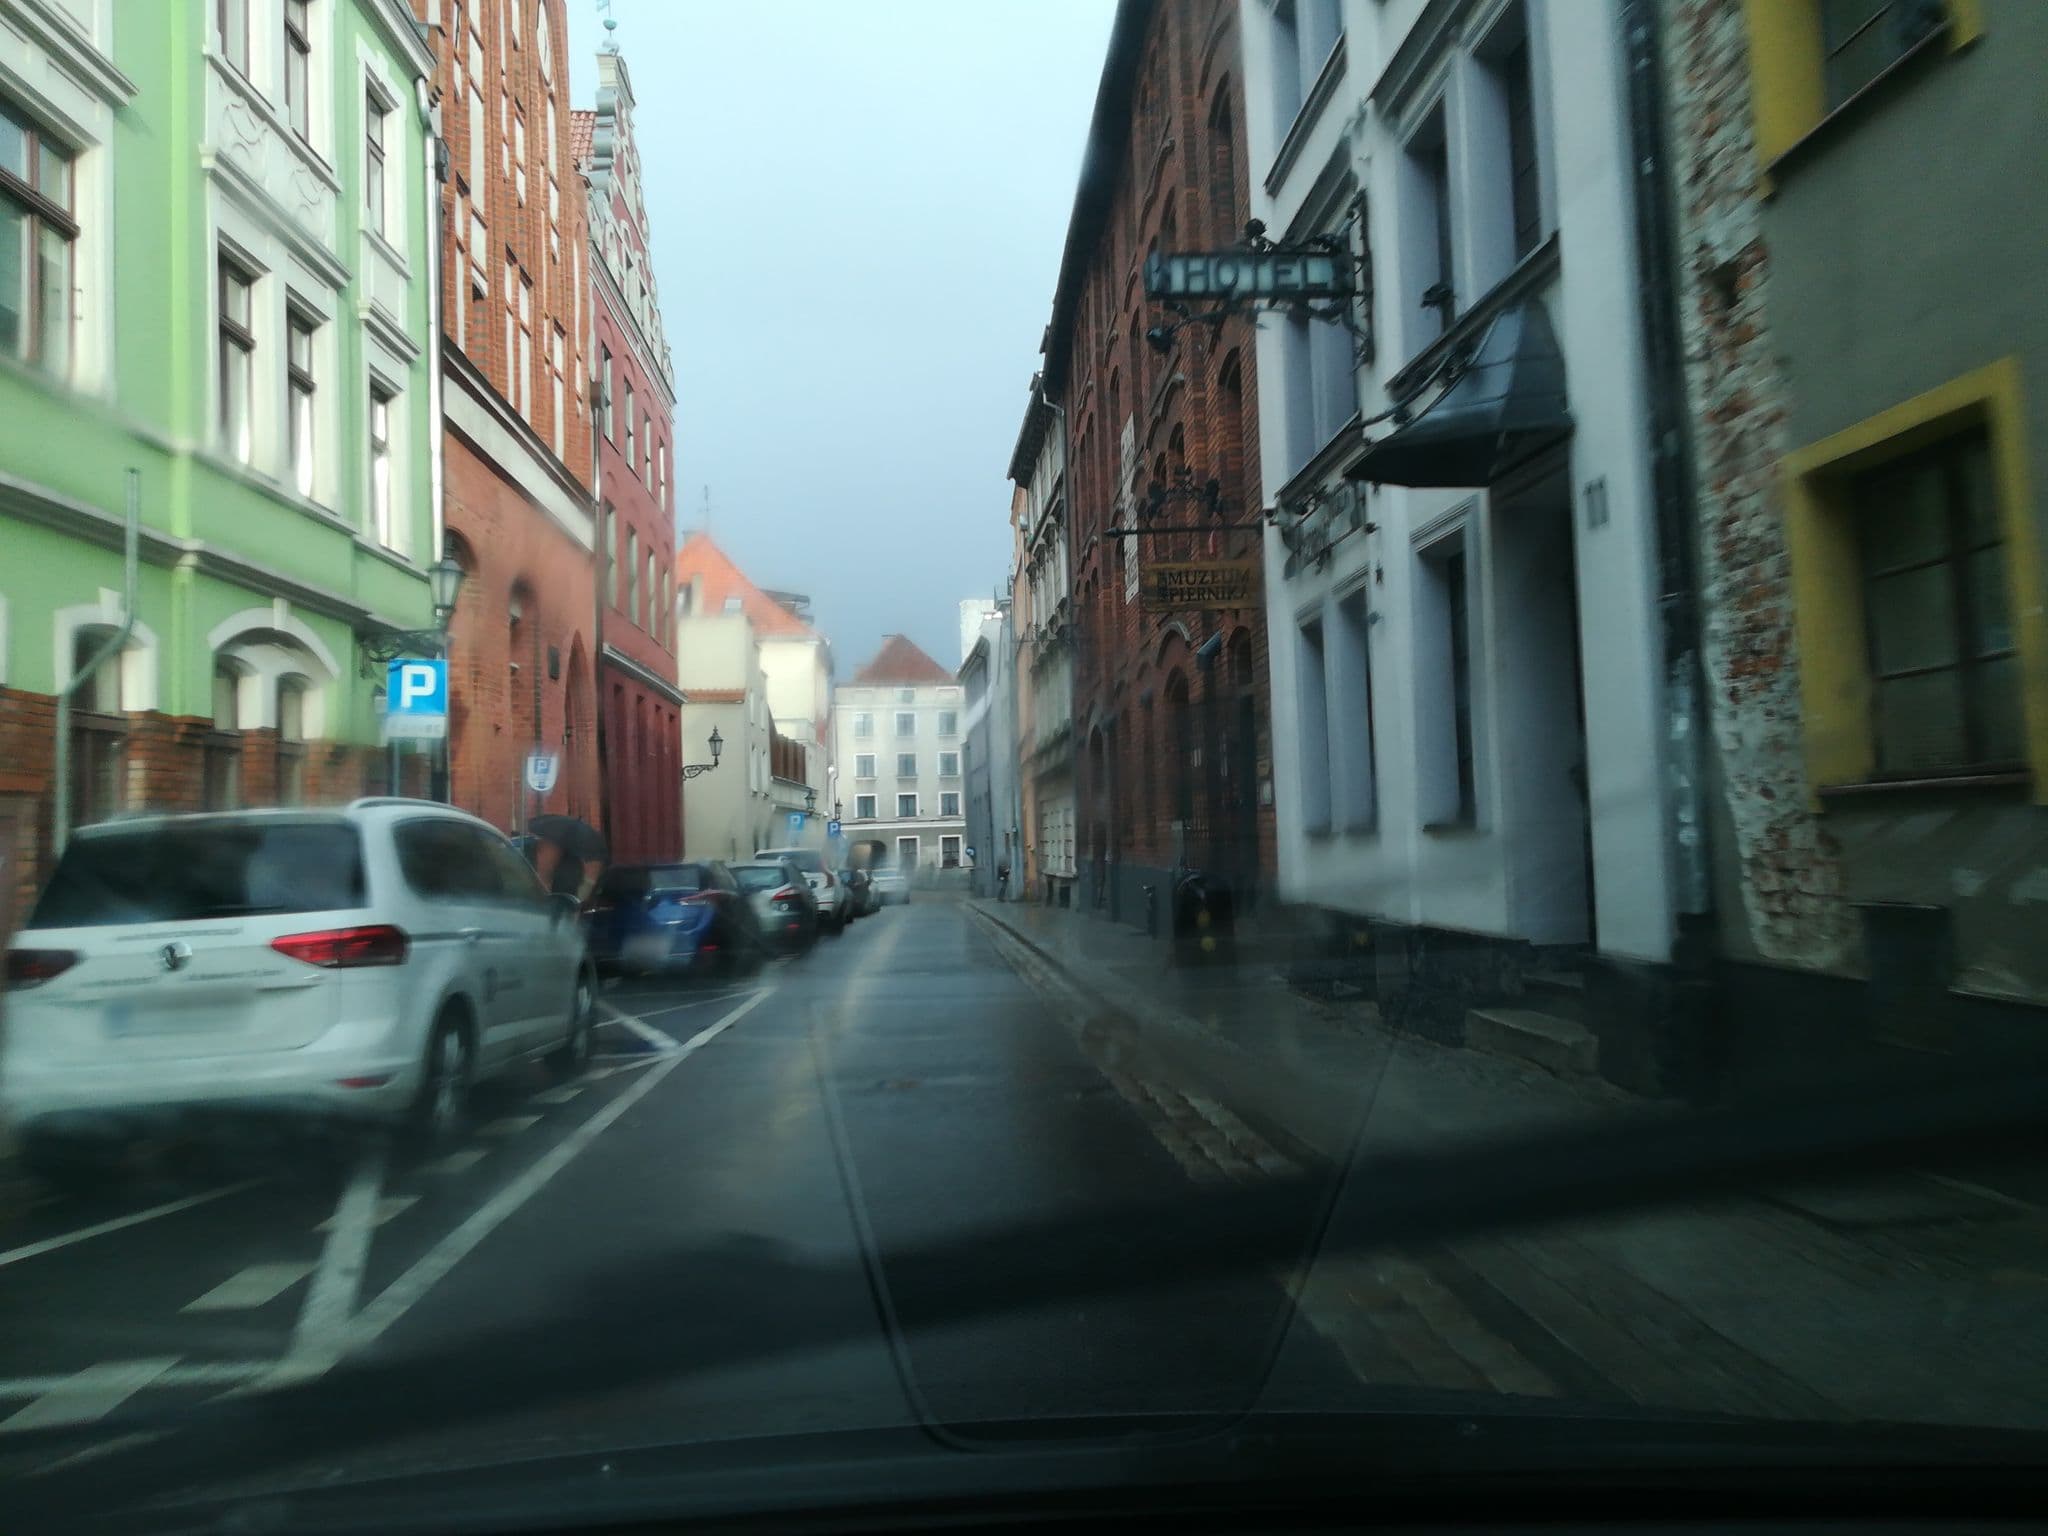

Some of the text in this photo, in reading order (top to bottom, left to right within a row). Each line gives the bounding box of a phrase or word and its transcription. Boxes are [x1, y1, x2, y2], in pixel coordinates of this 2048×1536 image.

[1183, 255, 1330, 291] HOTEL
[1168, 567, 1250, 586] MUZEUM
[400, 664, 437, 709] P
[830, 822, 839, 835] P
